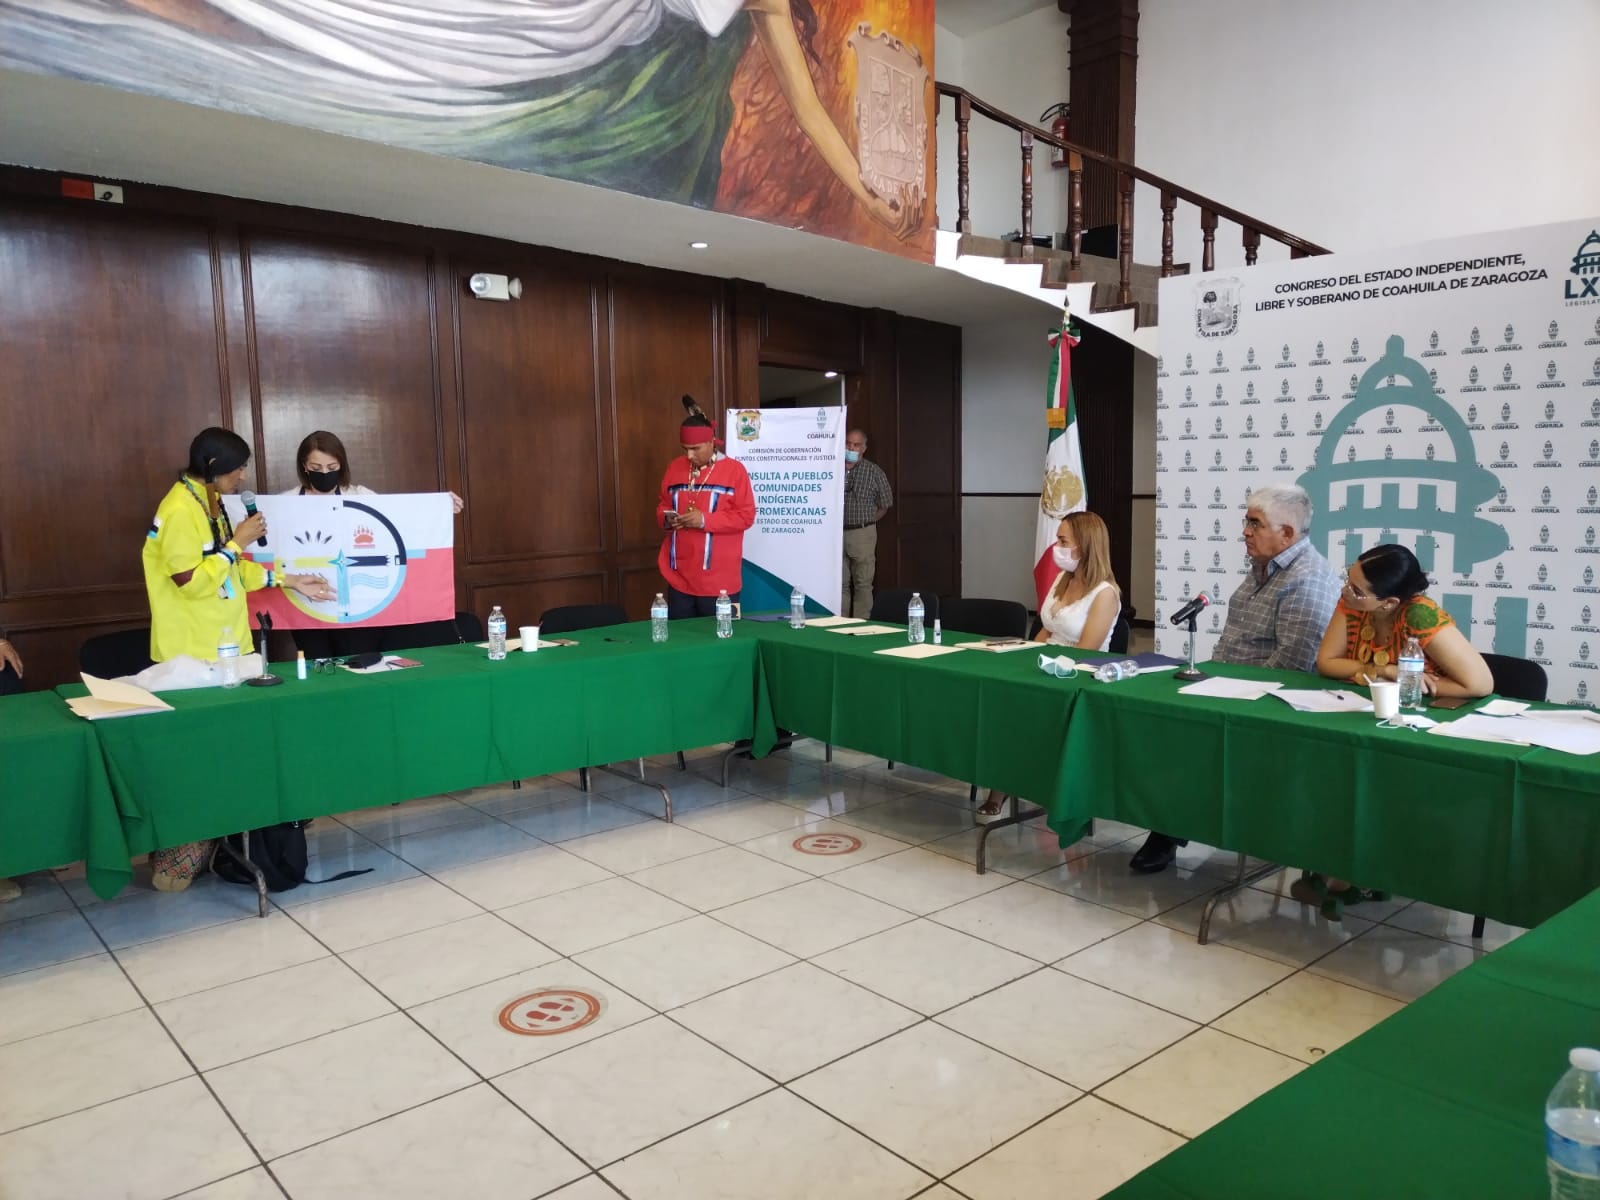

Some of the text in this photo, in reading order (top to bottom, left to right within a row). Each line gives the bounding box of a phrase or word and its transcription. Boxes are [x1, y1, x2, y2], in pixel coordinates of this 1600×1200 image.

[1275, 254, 1525, 294] CONGRESO DEL ESTADO INDEPENDIENTE,
[1256, 269, 1548, 312] LIBRE Y SOBERANO DE COAHUILA DE ZARAGOZA
[1564, 276, 1600, 299] LX
[1565, 299, 1600, 307] LEGISLAT
[748, 471, 833, 480] NSULTA A PUEBLOS
[753, 483, 822, 492] COMUNIDADES
[758, 494, 808, 504] INDÍGENAS
